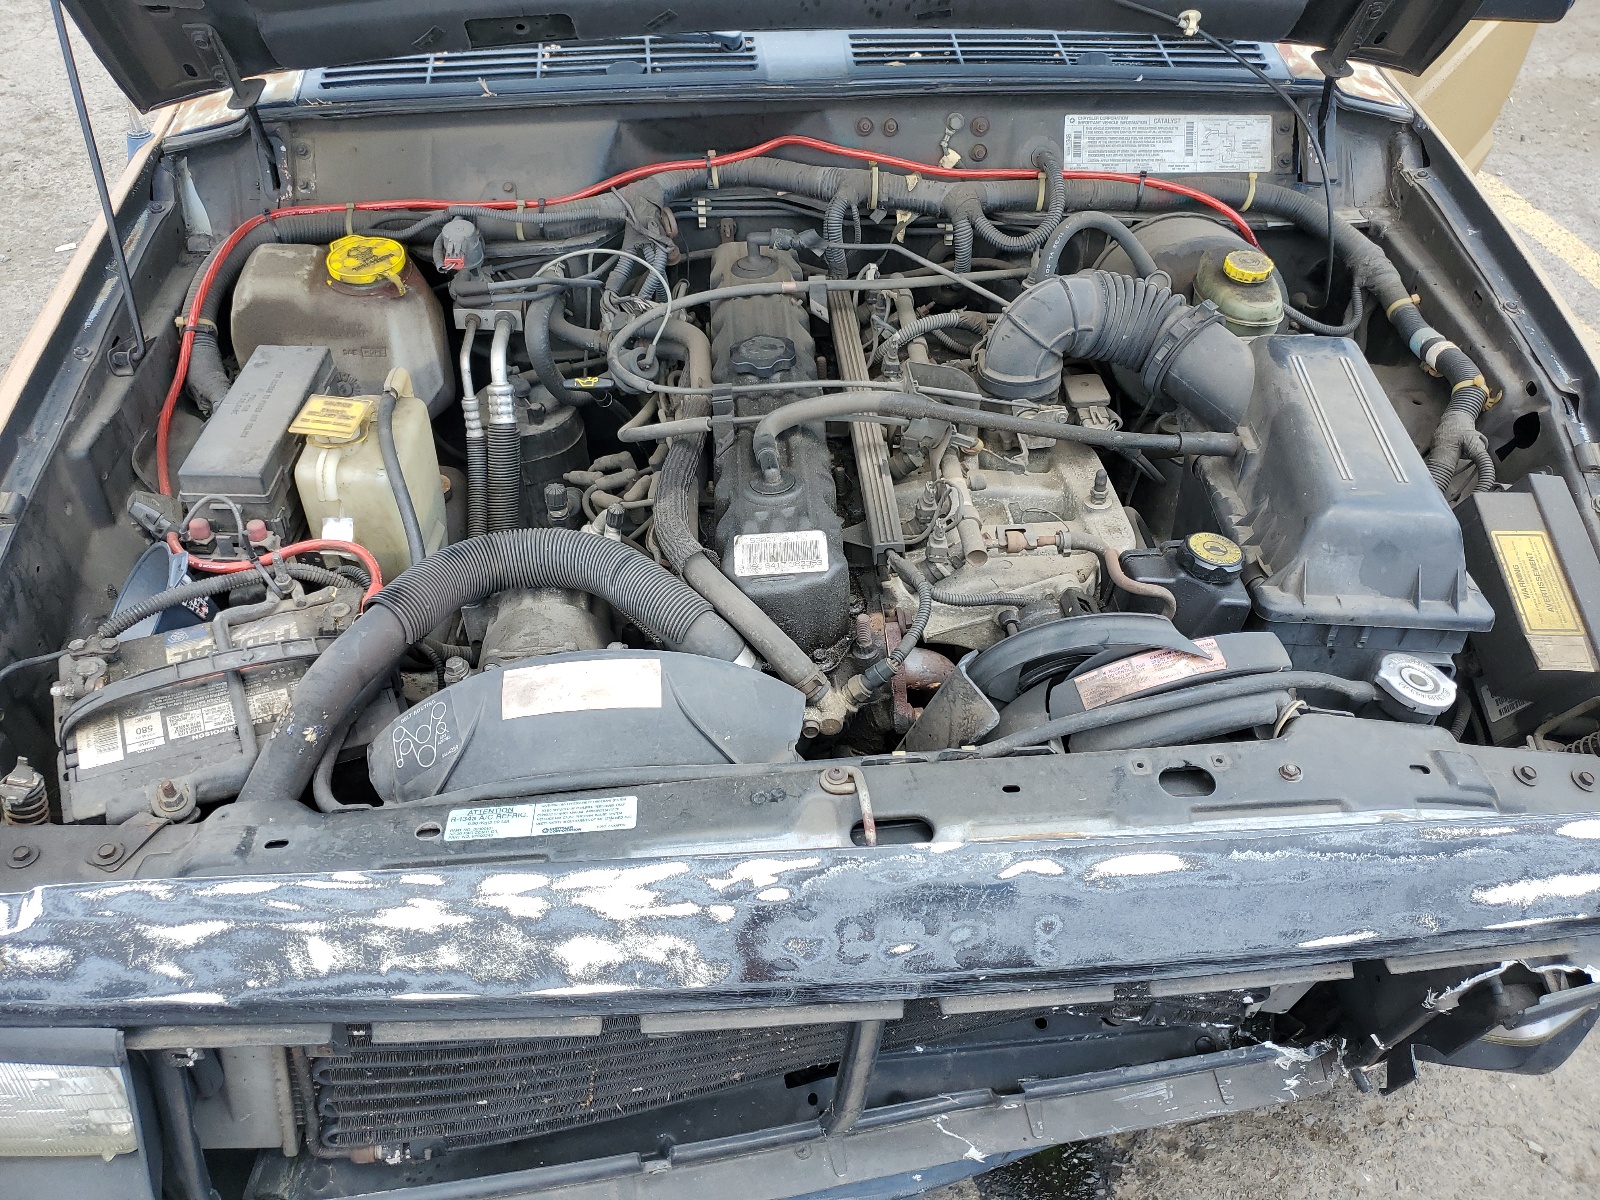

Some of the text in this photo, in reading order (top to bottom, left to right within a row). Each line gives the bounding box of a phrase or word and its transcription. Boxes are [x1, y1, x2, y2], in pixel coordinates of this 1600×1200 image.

[1512, 564, 1531, 600] WARNING
[1526, 551, 1555, 613] AVERTISSEMENT
[136, 724, 153, 735] 580
[467, 807, 514, 816] ATTENTION
